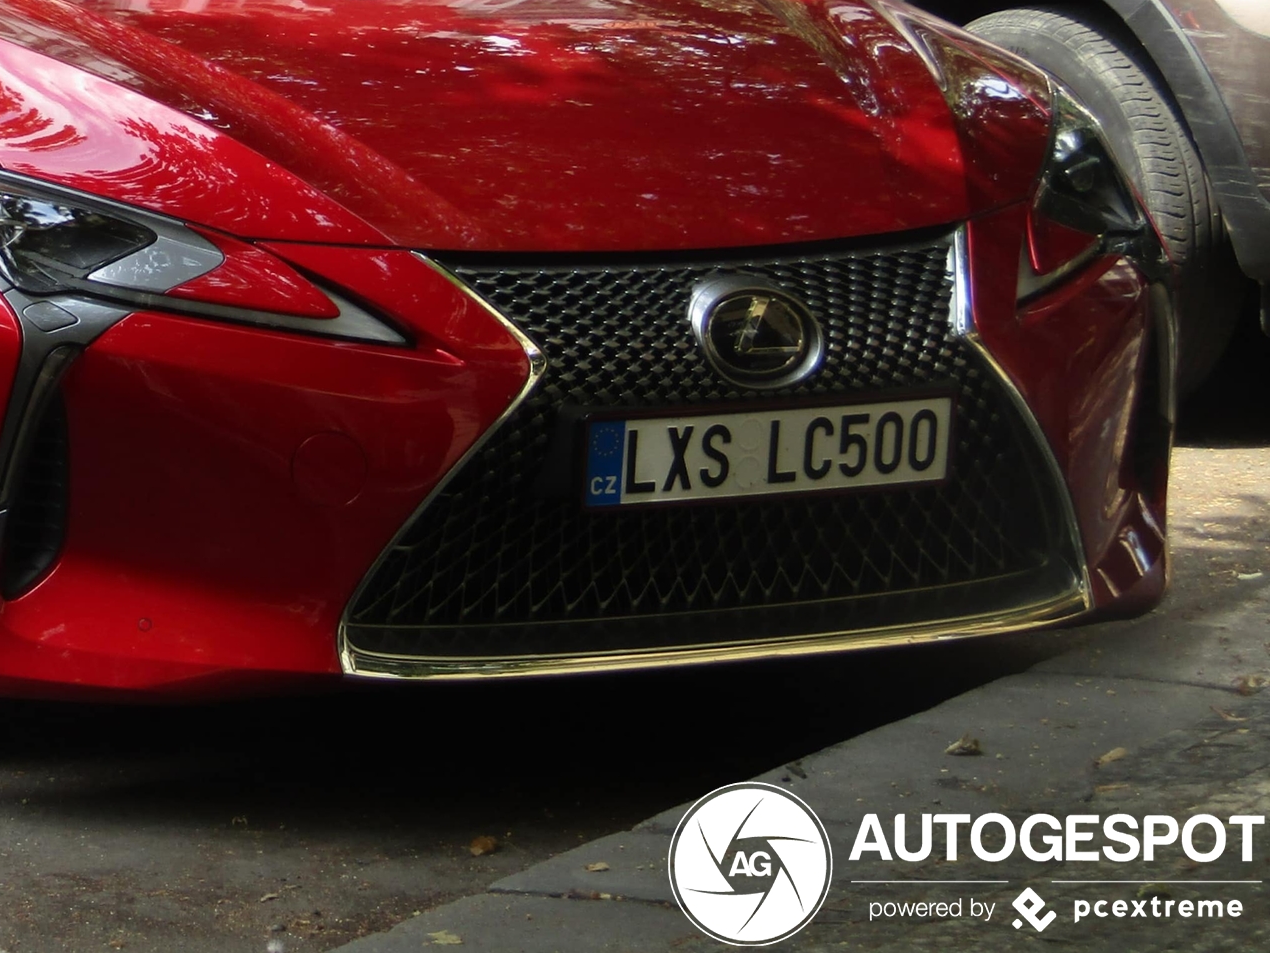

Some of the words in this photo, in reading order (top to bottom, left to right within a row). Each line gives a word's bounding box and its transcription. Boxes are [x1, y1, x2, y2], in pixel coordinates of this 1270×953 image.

[626, 424, 732, 494] LXS
[768, 409, 938, 484] LC500
[590, 476, 617, 495] CZ
